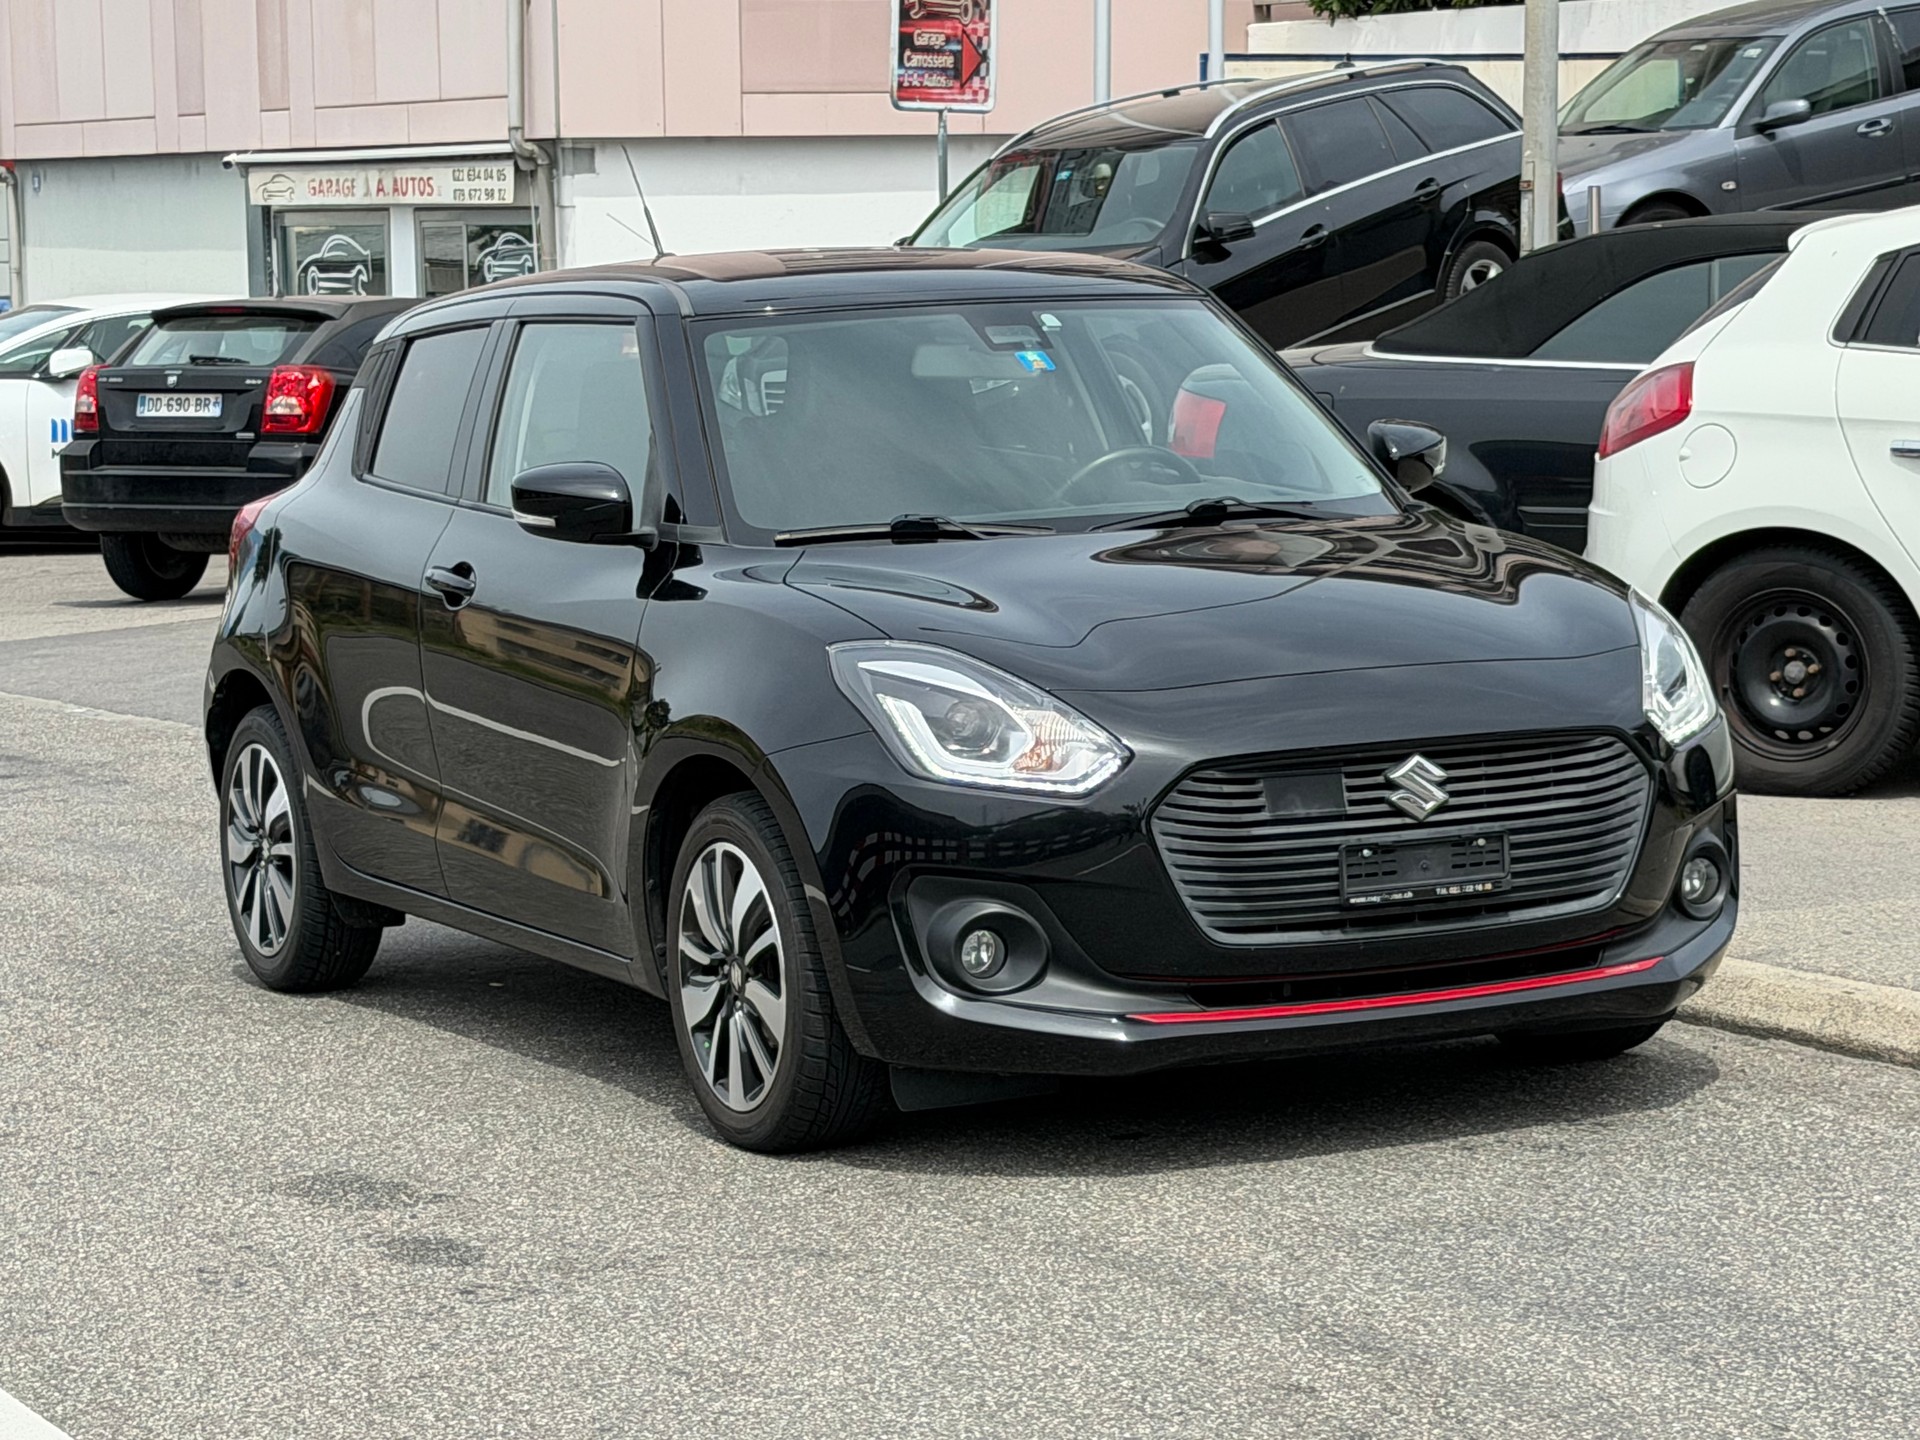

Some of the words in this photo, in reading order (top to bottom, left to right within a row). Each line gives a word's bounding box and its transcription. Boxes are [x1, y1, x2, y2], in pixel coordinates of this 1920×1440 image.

[913, 29, 946, 49] Garage
[903, 48, 955, 68] Carrosserie
[307, 178, 356, 198] GARAGE
[146, 396, 211, 413] DD-690-BR
